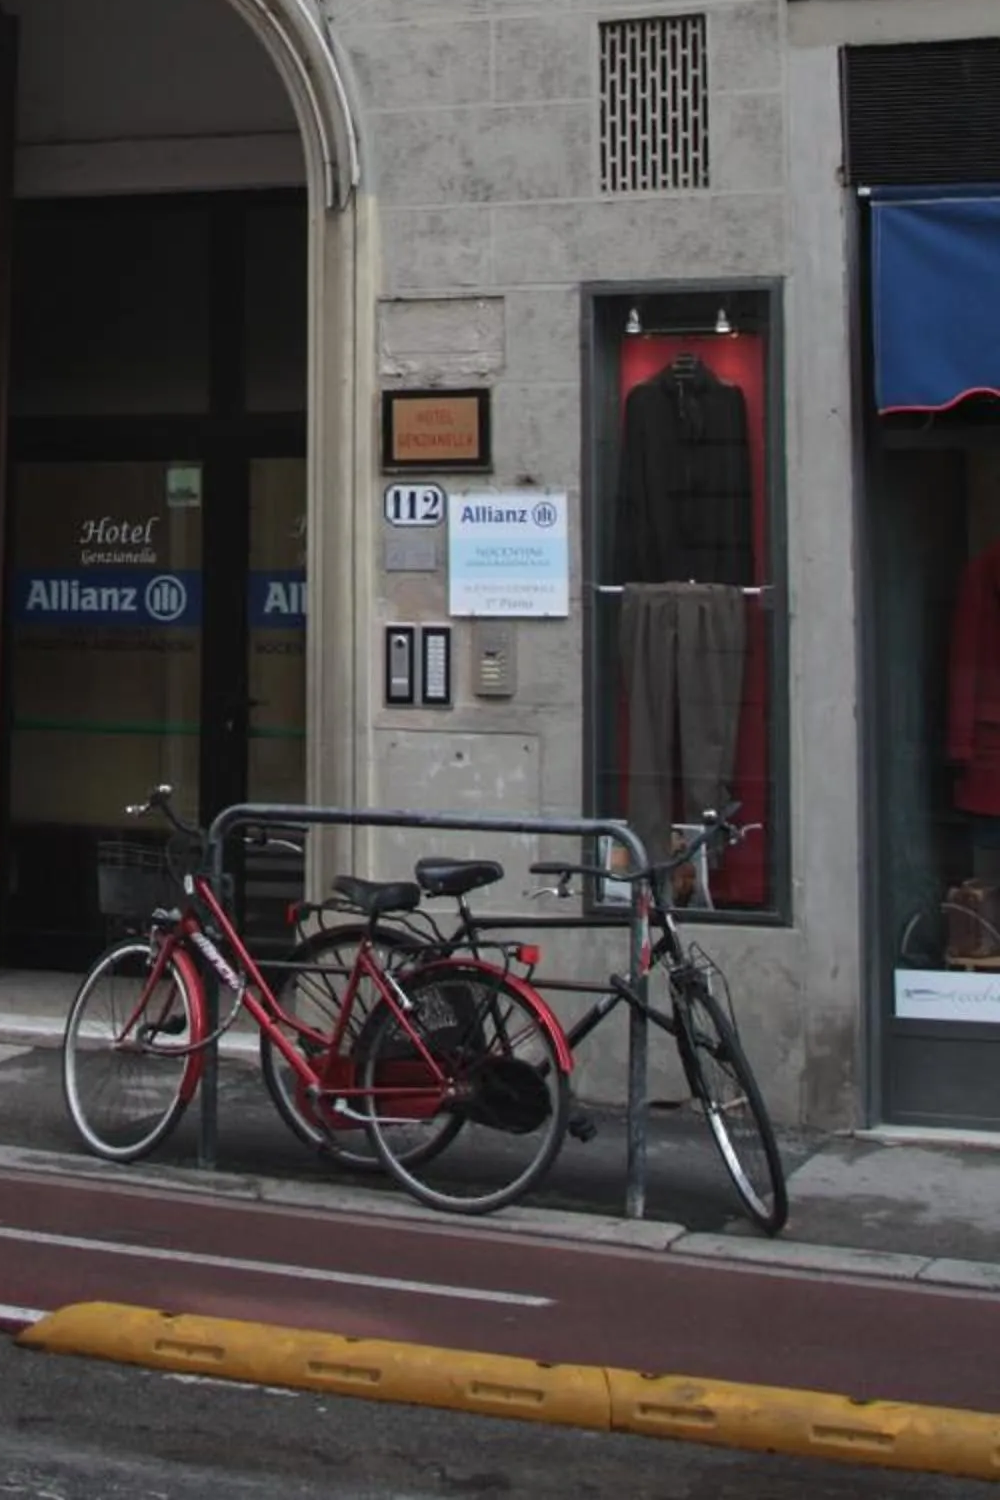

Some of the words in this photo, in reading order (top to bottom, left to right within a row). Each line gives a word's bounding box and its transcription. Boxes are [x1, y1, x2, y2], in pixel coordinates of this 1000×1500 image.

[392, 490, 440, 520] 112
[460, 505, 528, 523] Allianz
[80, 516, 160, 545] Hotel
[26, 579, 138, 612] Allianz
